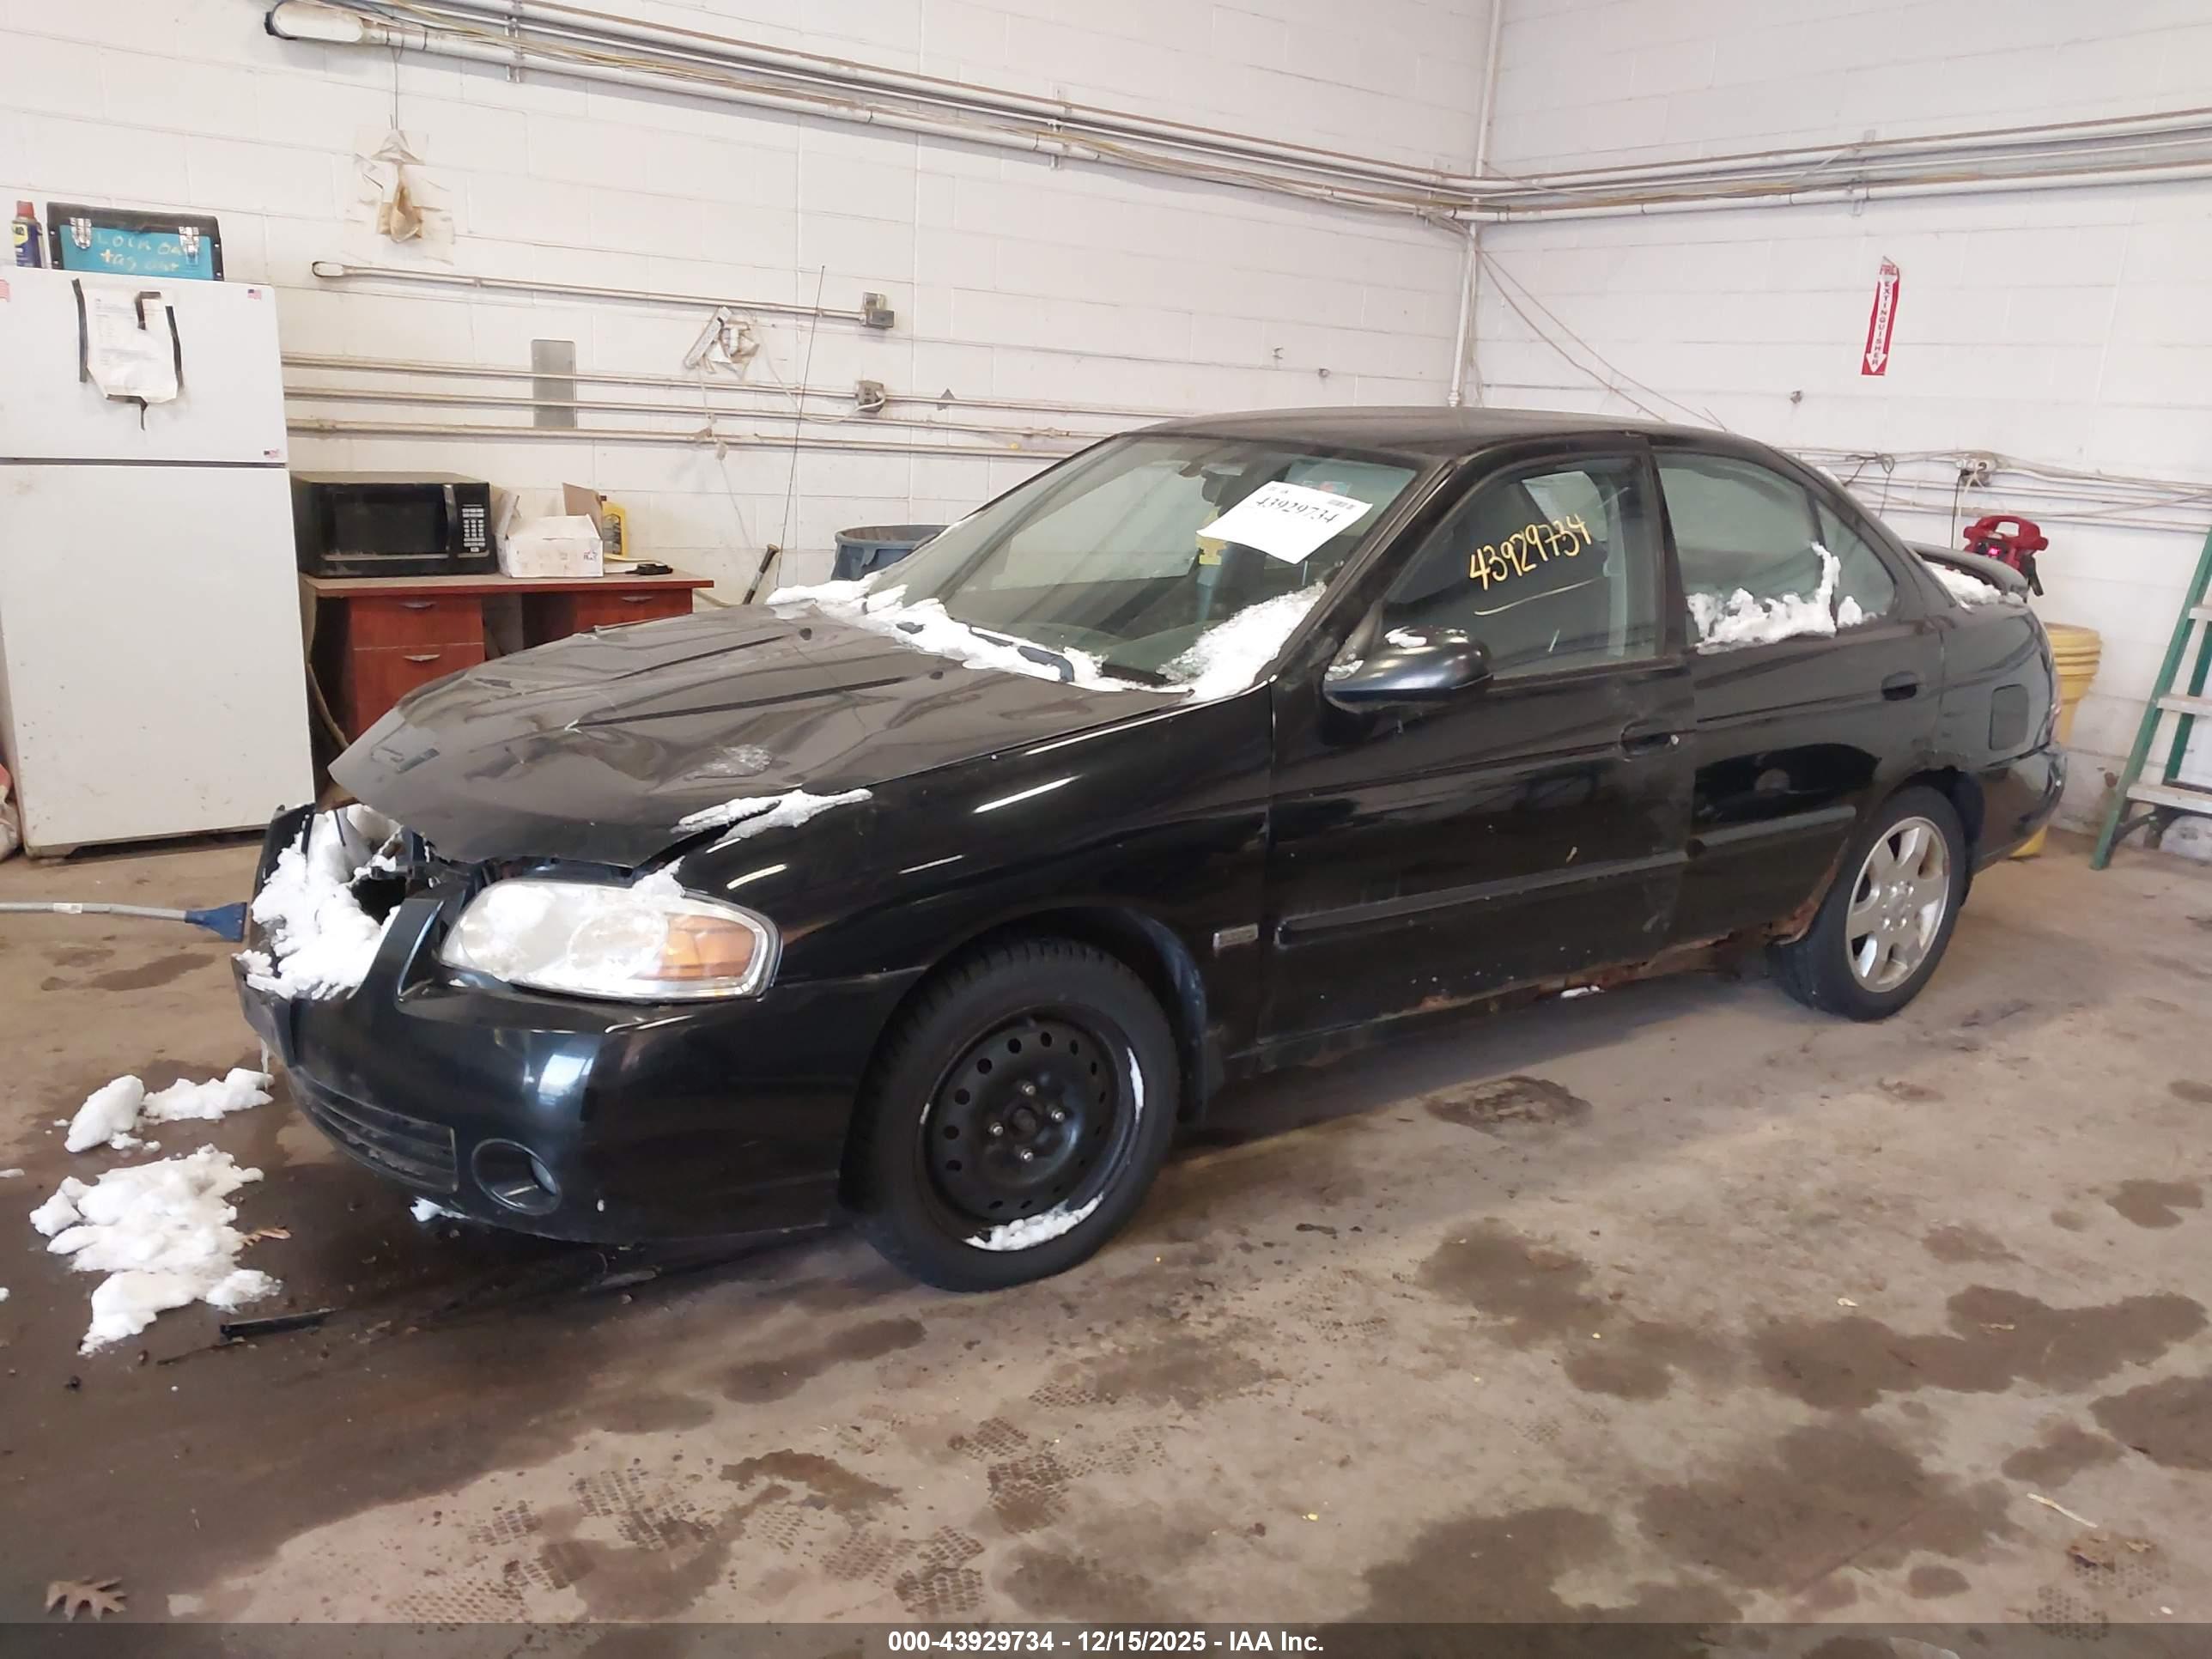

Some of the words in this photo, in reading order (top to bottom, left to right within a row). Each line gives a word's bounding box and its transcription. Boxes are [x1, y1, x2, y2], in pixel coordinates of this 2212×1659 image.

[1871, 281, 1890, 366] EXTINGUISHER
[1256, 496, 1340, 523] 43929734
[1469, 513, 1592, 591] 43929734
